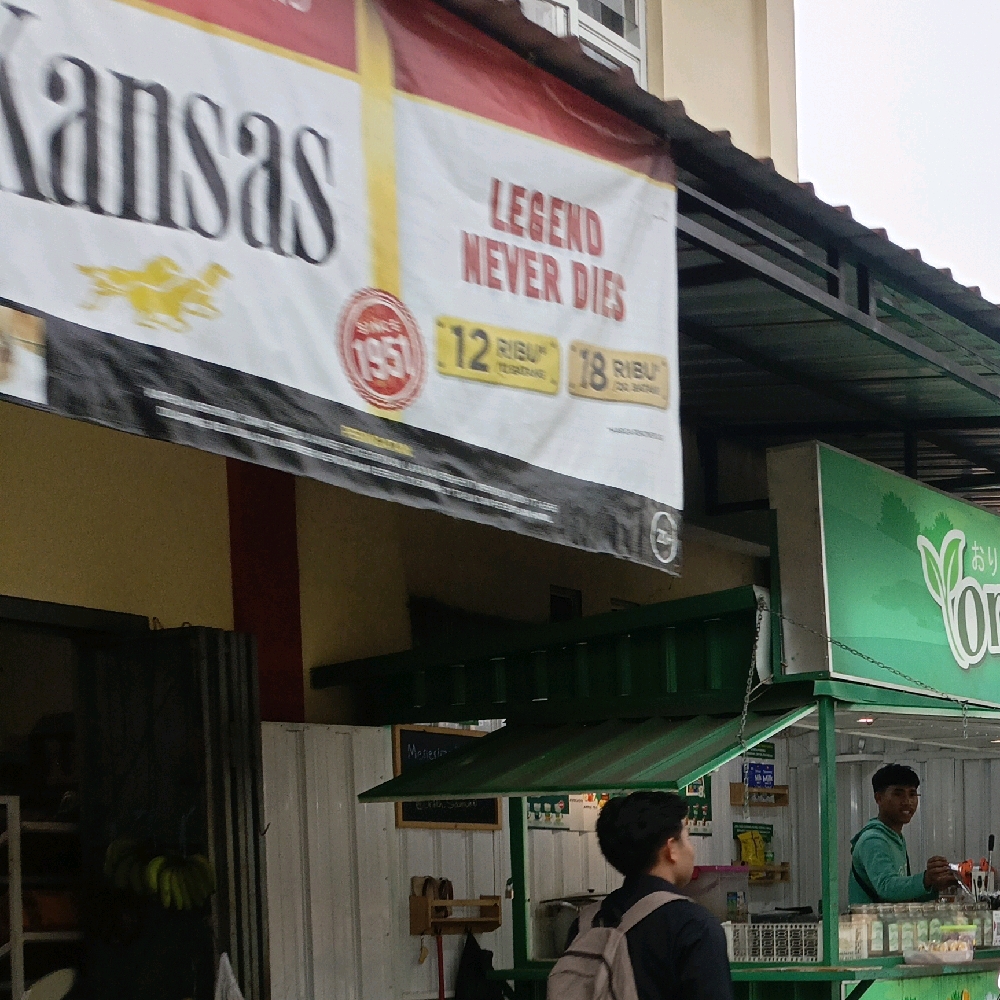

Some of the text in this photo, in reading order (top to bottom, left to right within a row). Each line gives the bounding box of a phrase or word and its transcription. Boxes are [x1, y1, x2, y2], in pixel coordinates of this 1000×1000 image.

[490, 177, 604, 258] LEGEND
[461, 230, 626, 322] NEVER DIES
[451, 323, 491, 373] 12
[579, 348, 609, 392] 18
